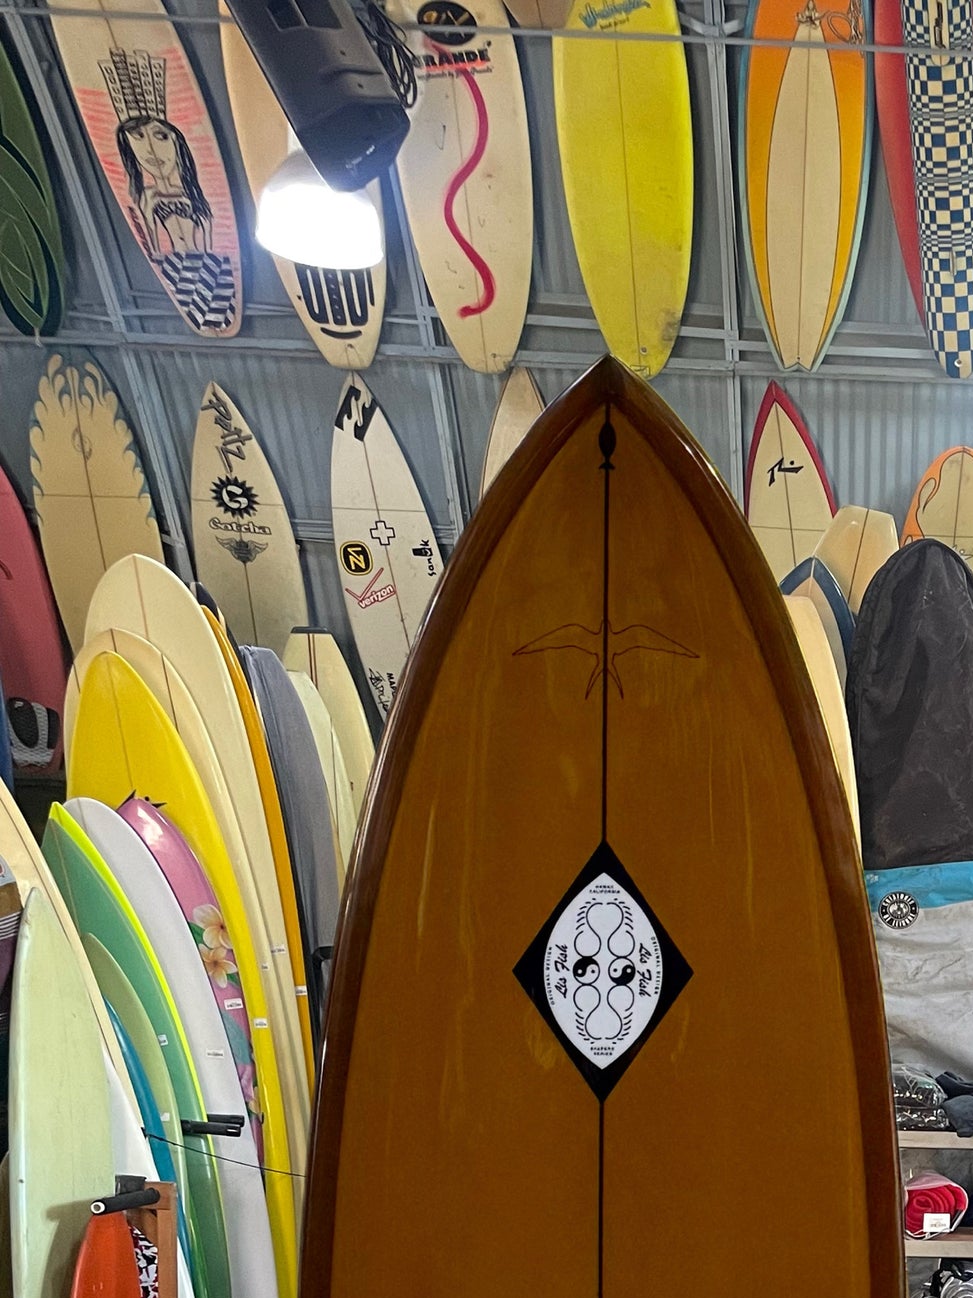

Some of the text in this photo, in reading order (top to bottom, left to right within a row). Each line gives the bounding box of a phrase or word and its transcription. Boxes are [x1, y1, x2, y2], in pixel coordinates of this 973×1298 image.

[209, 517, 272, 535] Gotcha
[358, 584, 398, 610] verizon
[554, 944, 570, 973] Fish
[636, 969, 652, 997] Fish
